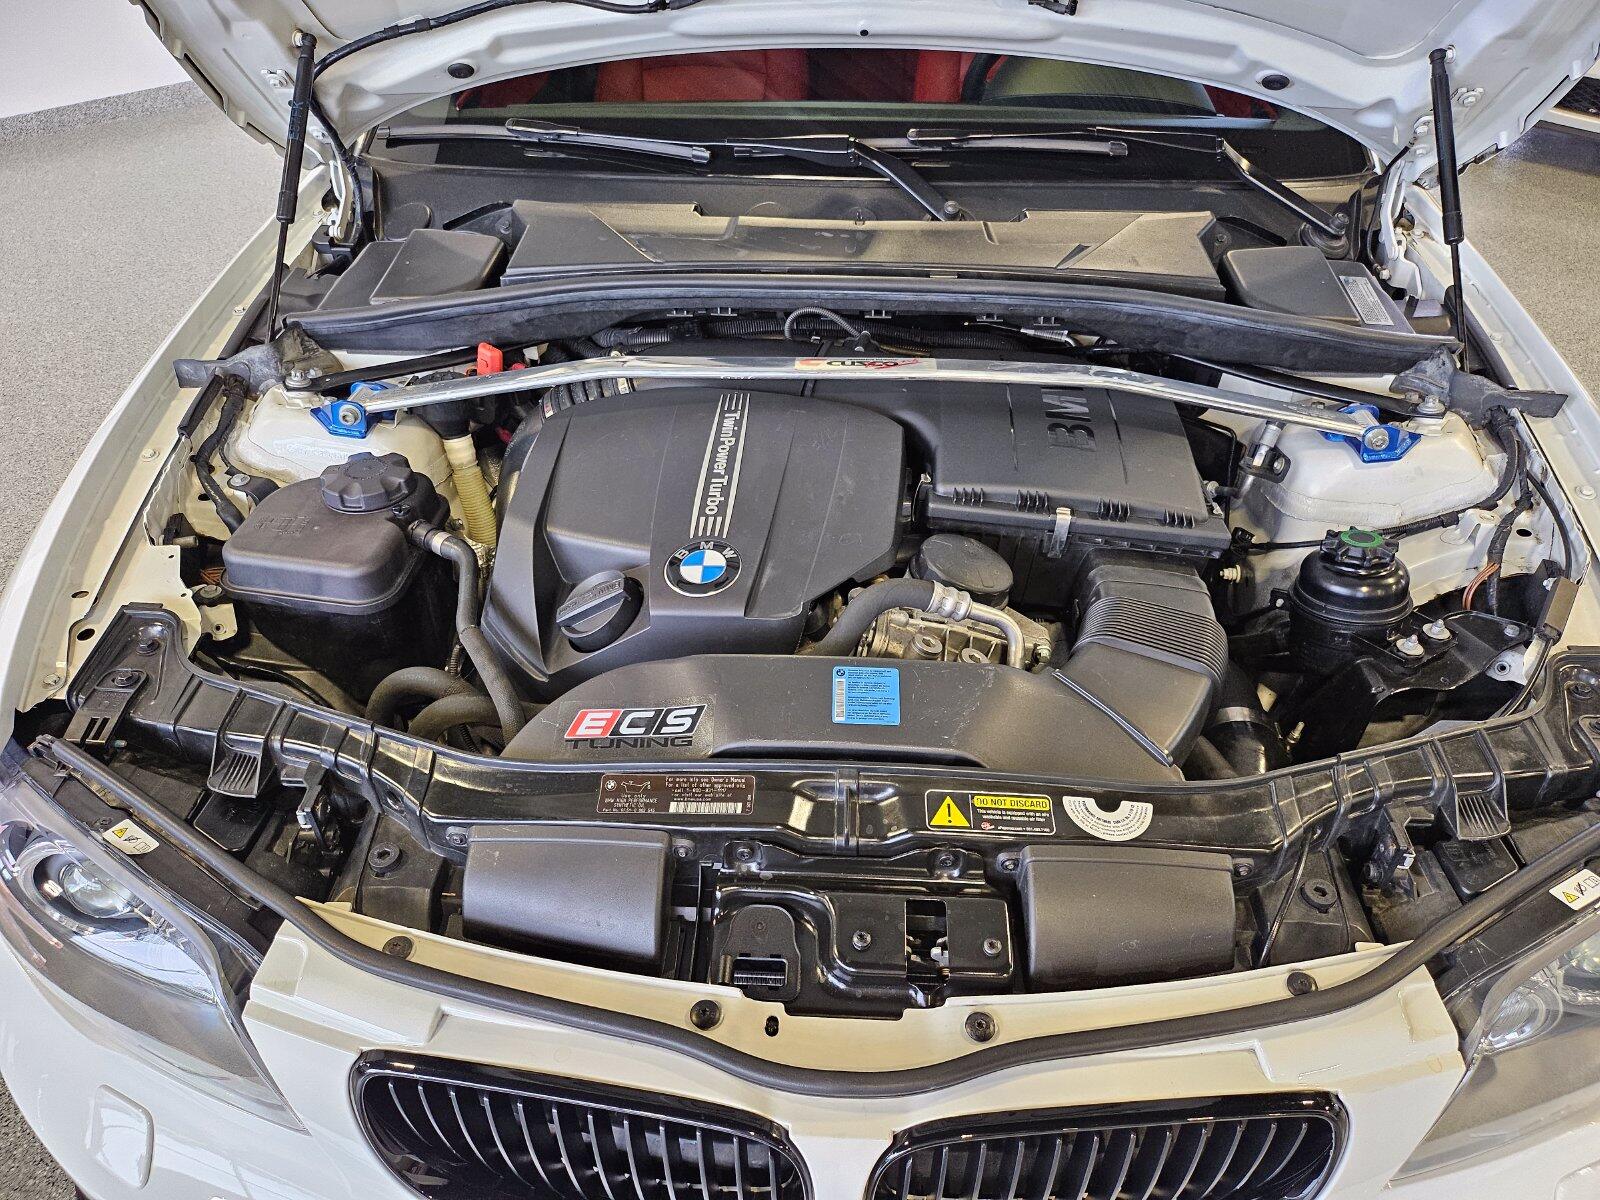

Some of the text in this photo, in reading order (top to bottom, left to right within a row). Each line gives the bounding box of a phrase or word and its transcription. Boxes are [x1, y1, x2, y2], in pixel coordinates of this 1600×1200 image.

[705, 411, 740, 515] TwinPower Turbo
[675, 541, 737, 560] BMW
[575, 708, 698, 735] ECS
[565, 736, 694, 749] TUNING
[976, 797, 1048, 809] DO NOT DISCARD
